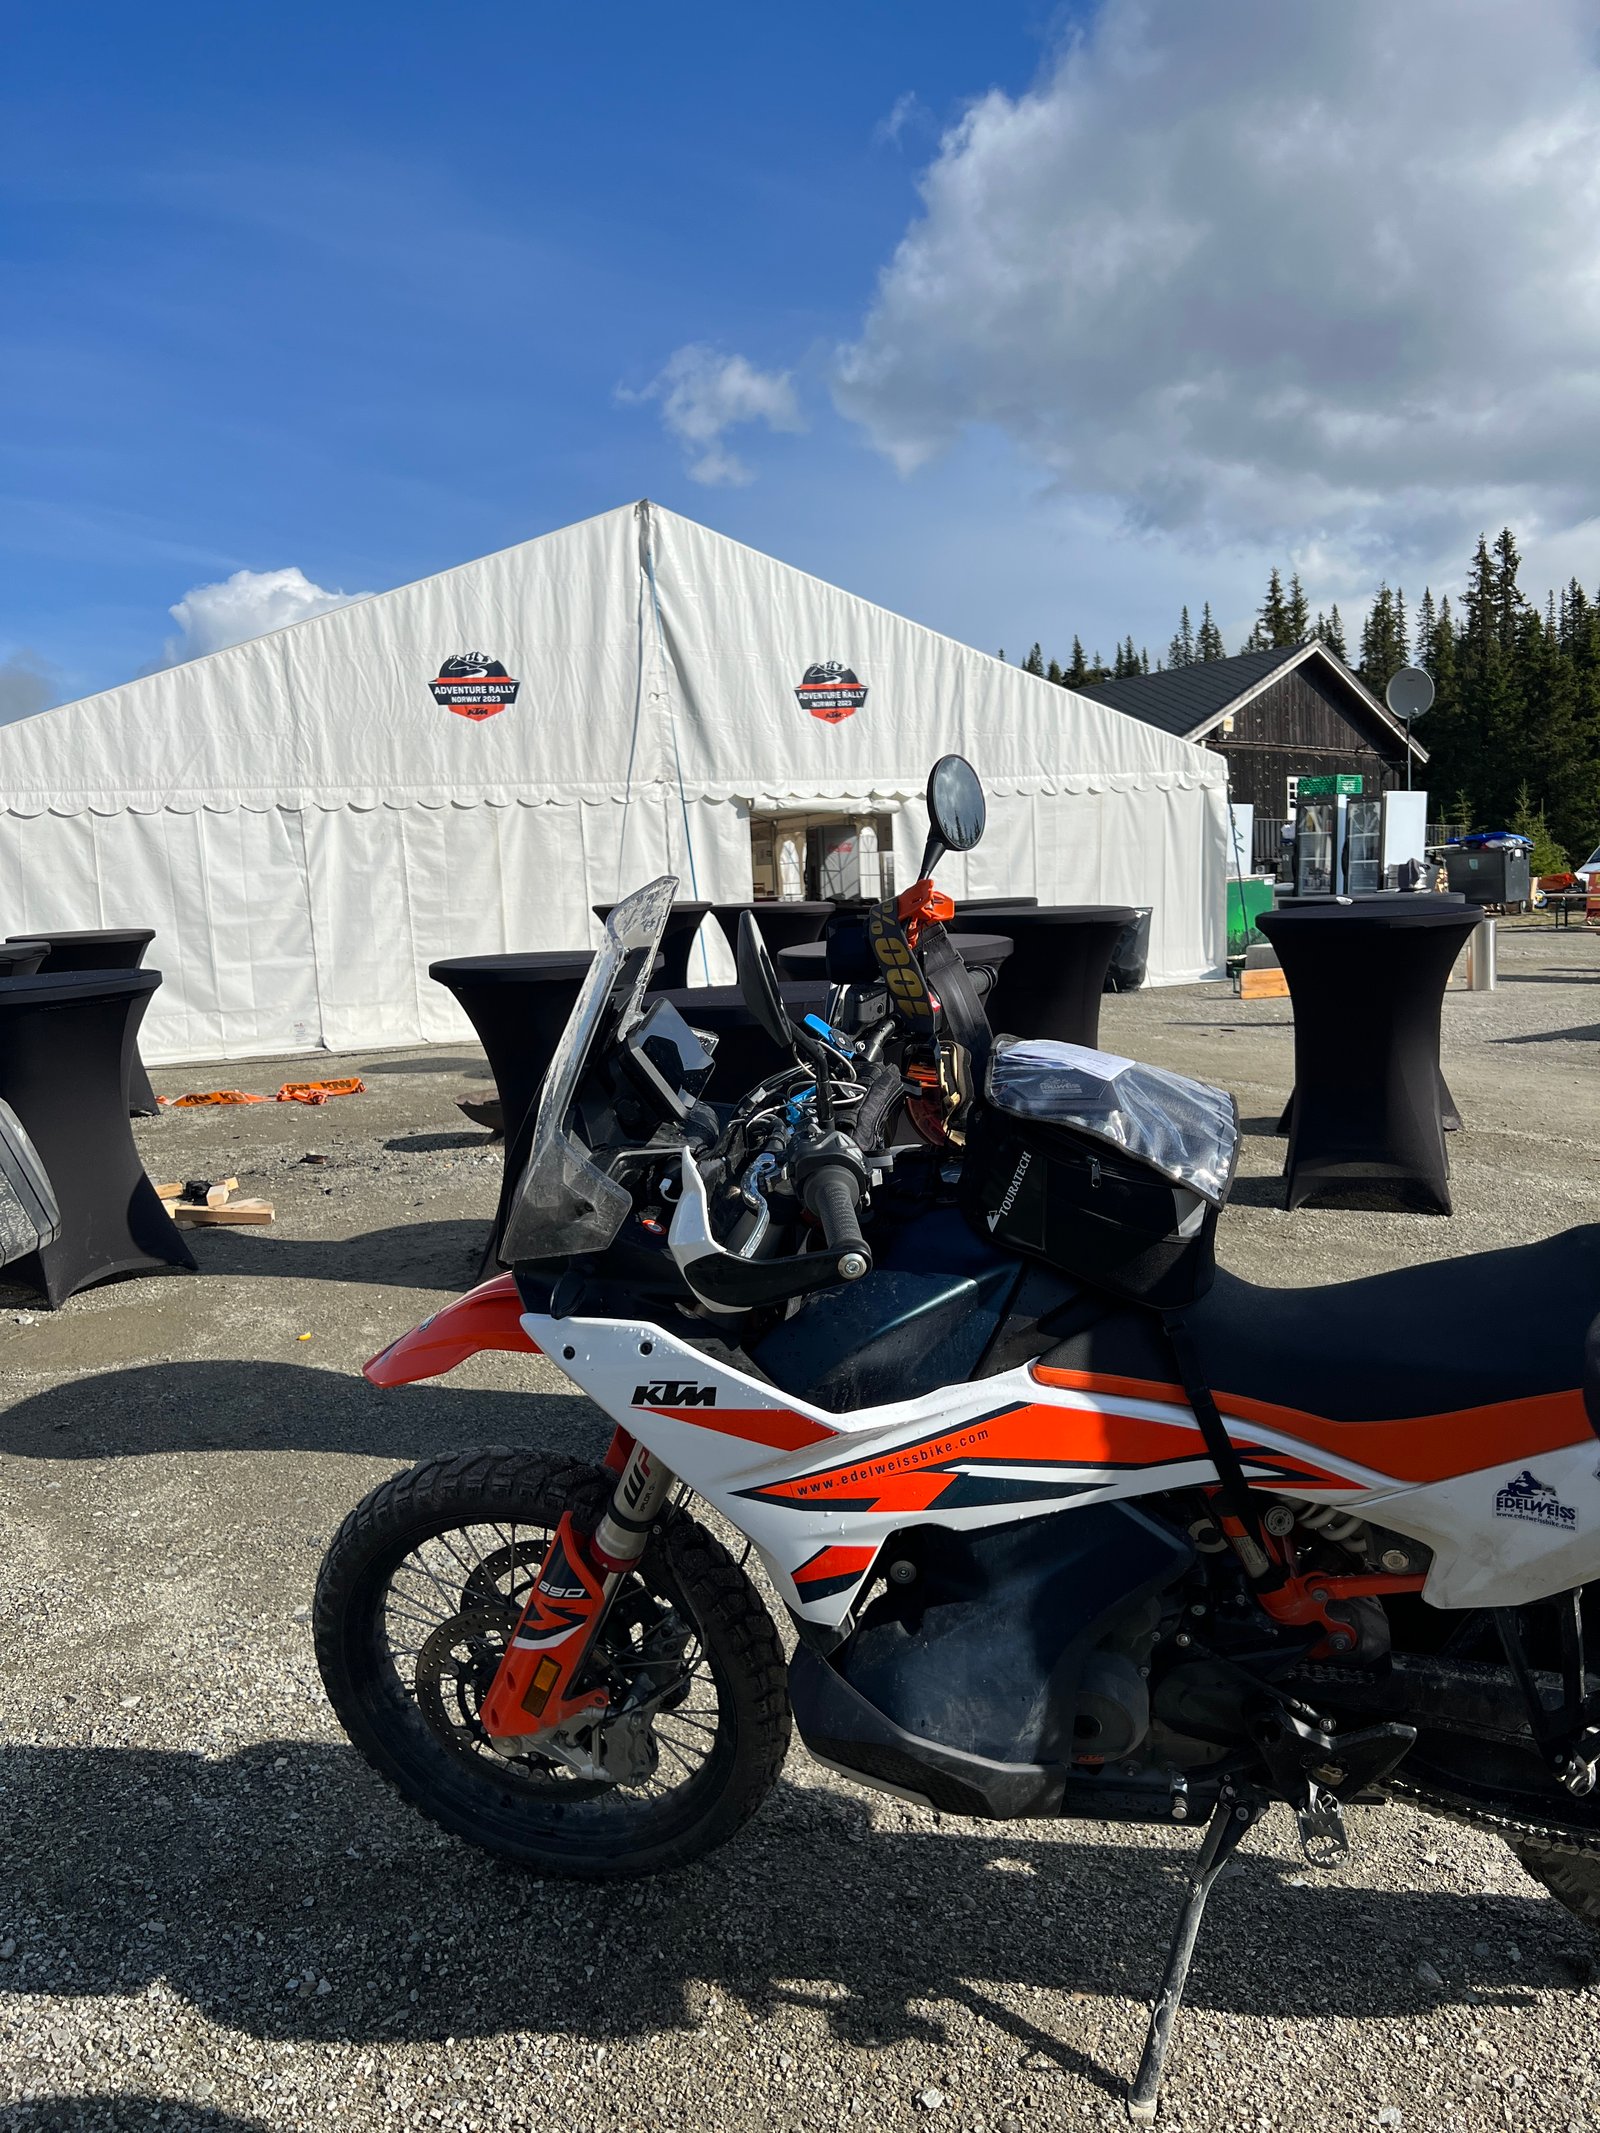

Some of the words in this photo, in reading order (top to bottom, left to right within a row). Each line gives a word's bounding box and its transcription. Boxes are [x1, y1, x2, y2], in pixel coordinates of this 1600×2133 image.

[434, 686, 487, 694] ADVENTURE
[489, 685, 515, 693] RALLY
[799, 691, 841, 699] ADVENTURE
[842, 690, 865, 698] RALLY
[870, 901, 930, 1019] 100%
[999, 1151, 1032, 1216] TOURATECH
[631, 1381, 717, 1406] KTM
[797, 1429, 989, 1496] www.edelweissbike.com
[1496, 1497, 1576, 1520] EDELWEISS
[1496, 1512, 1576, 1531] www.edelweissbike.com
[538, 1580, 586, 1598] 890
